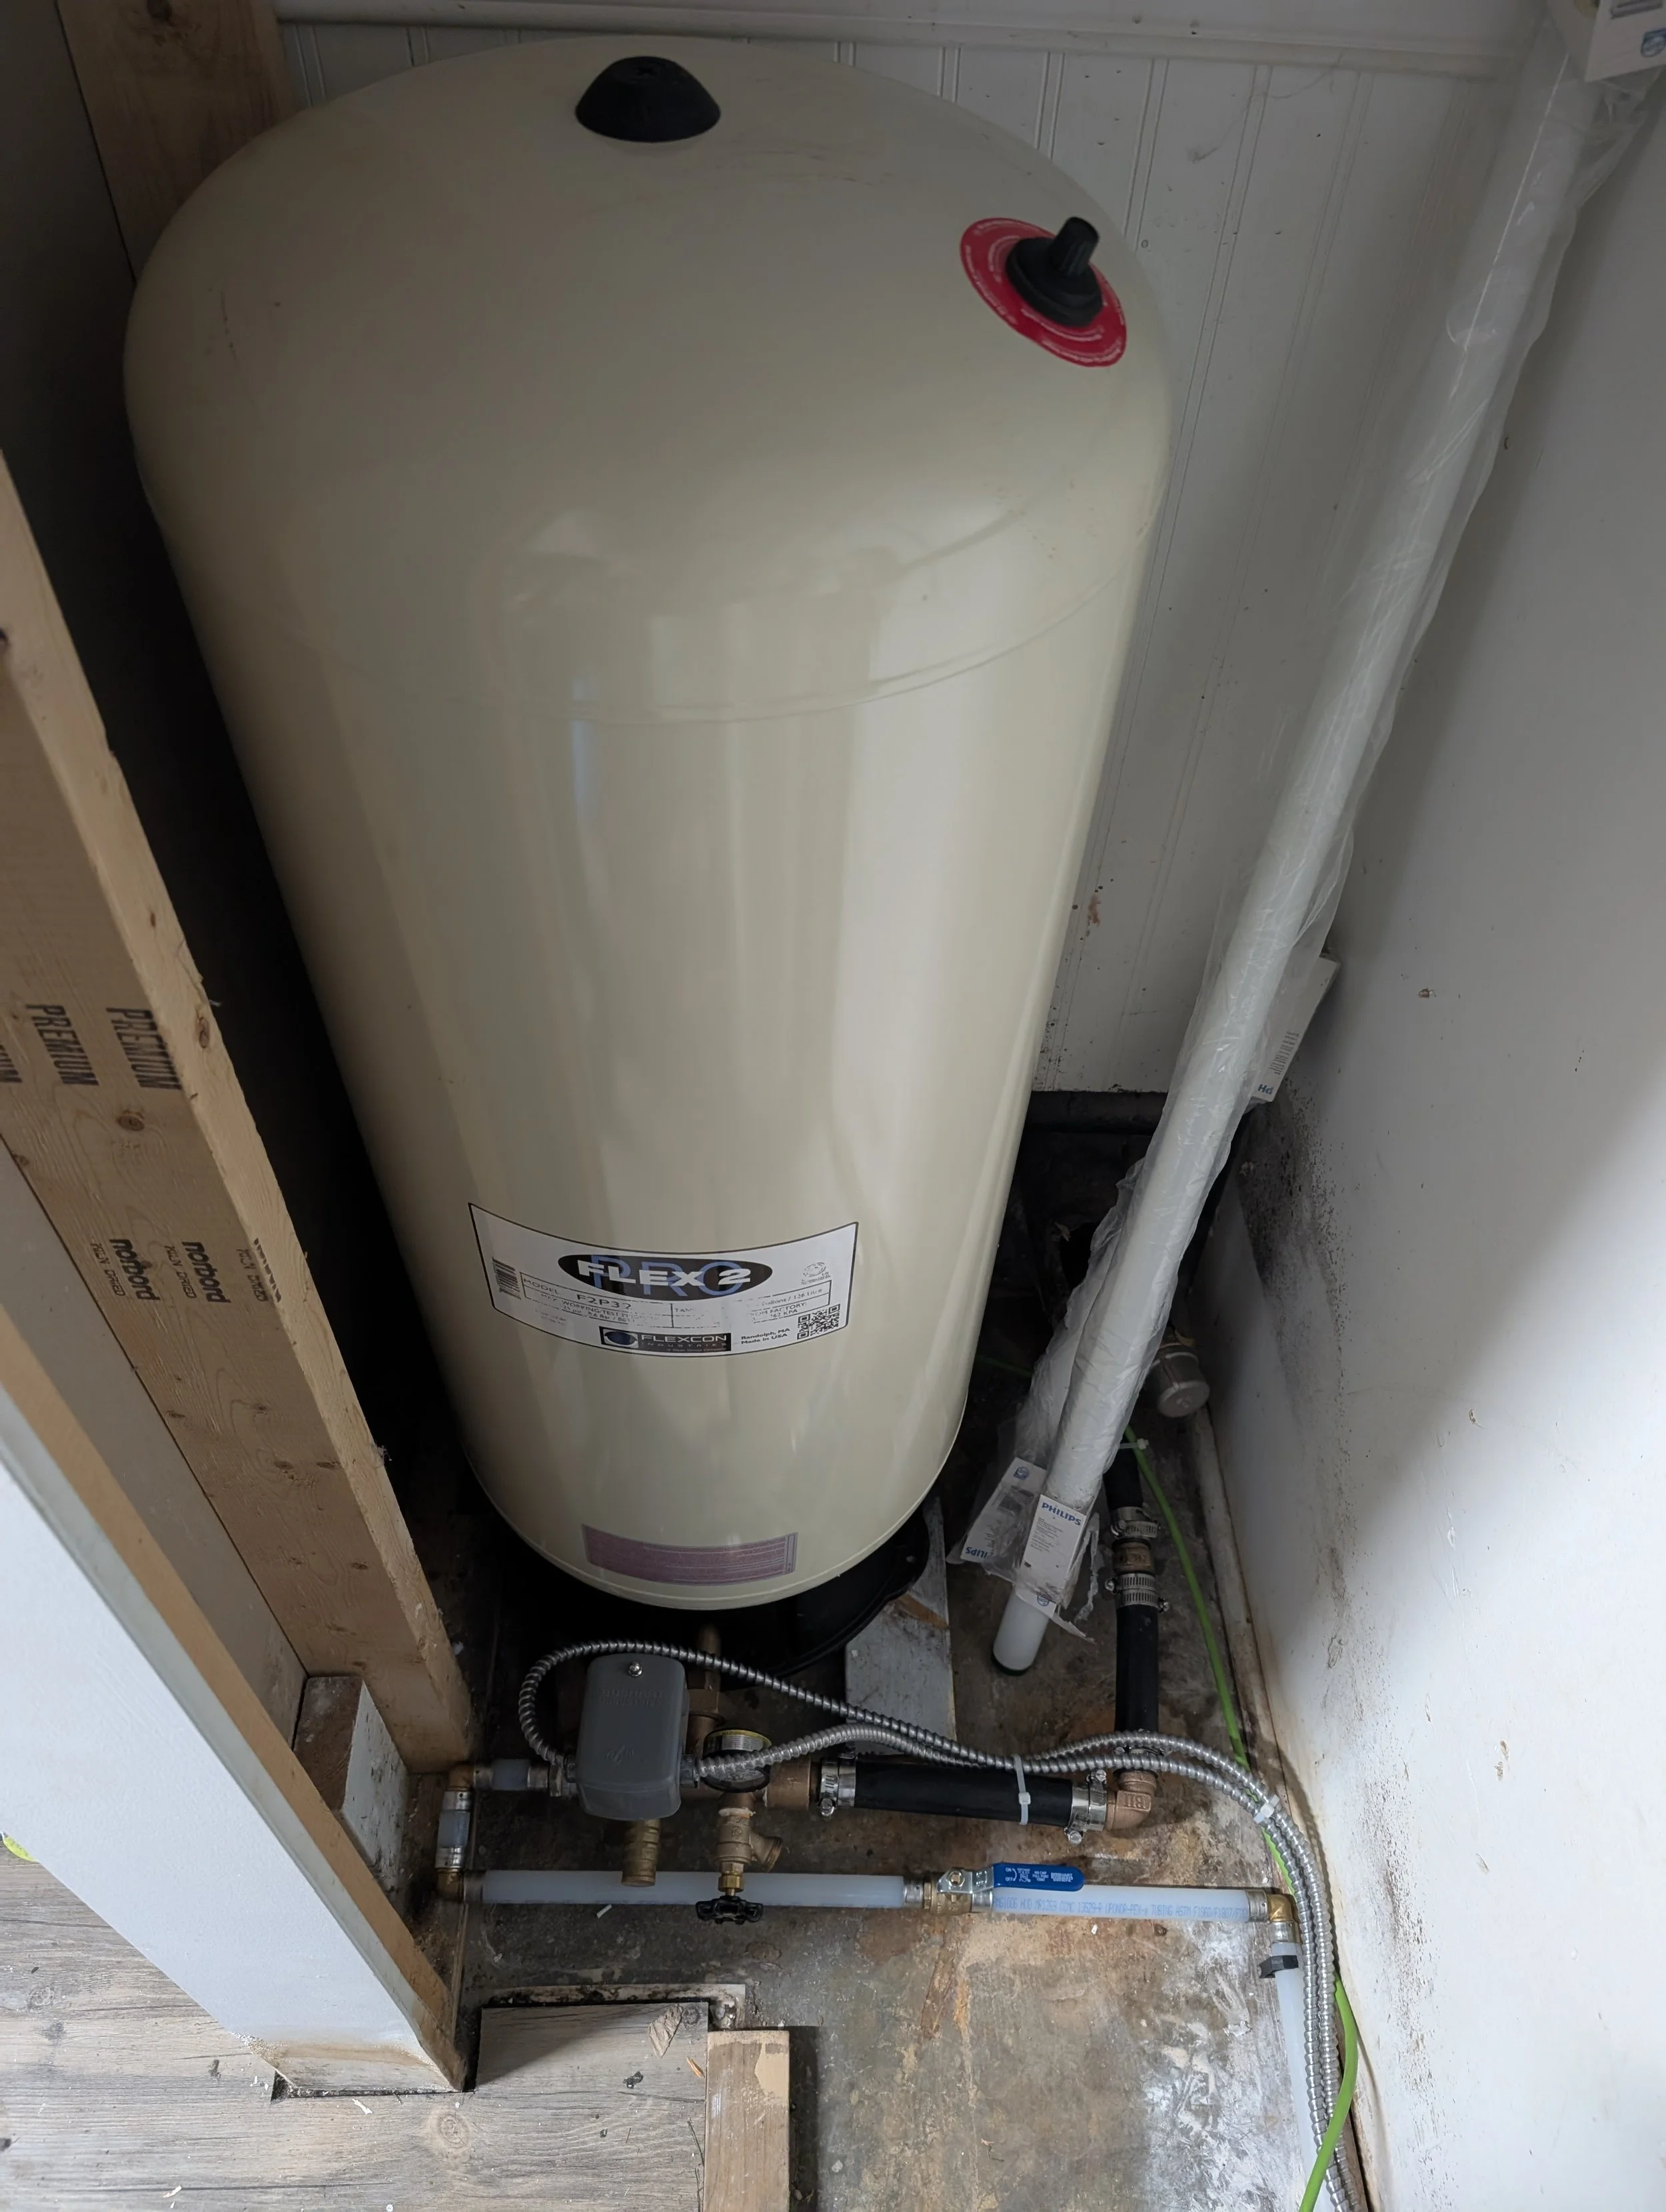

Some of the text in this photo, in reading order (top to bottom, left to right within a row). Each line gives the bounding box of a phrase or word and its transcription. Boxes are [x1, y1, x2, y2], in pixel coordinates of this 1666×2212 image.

[26, 1004, 99, 1086] PREMIUM
[106, 1007, 183, 1091] PREMIUM
[90, 1243, 125, 1297] KILN DRIED
[109, 1239, 161, 1301] norbord
[163, 1245, 198, 1299] KILN DRIED
[182, 1241, 231, 1304] norbord
[577, 1260, 751, 1287] FLEX 2
[524, 1279, 632, 1309] MODEL F2P32
[741, 1331, 776, 1340] Randolph,
[1042, 1502, 1081, 1526] PHILIPS
[964, 1546, 988, 1559] ILIPS
[1150, 1904, 1173, 1916] TUBING
[1176, 1905, 1192, 1917] ASTM
